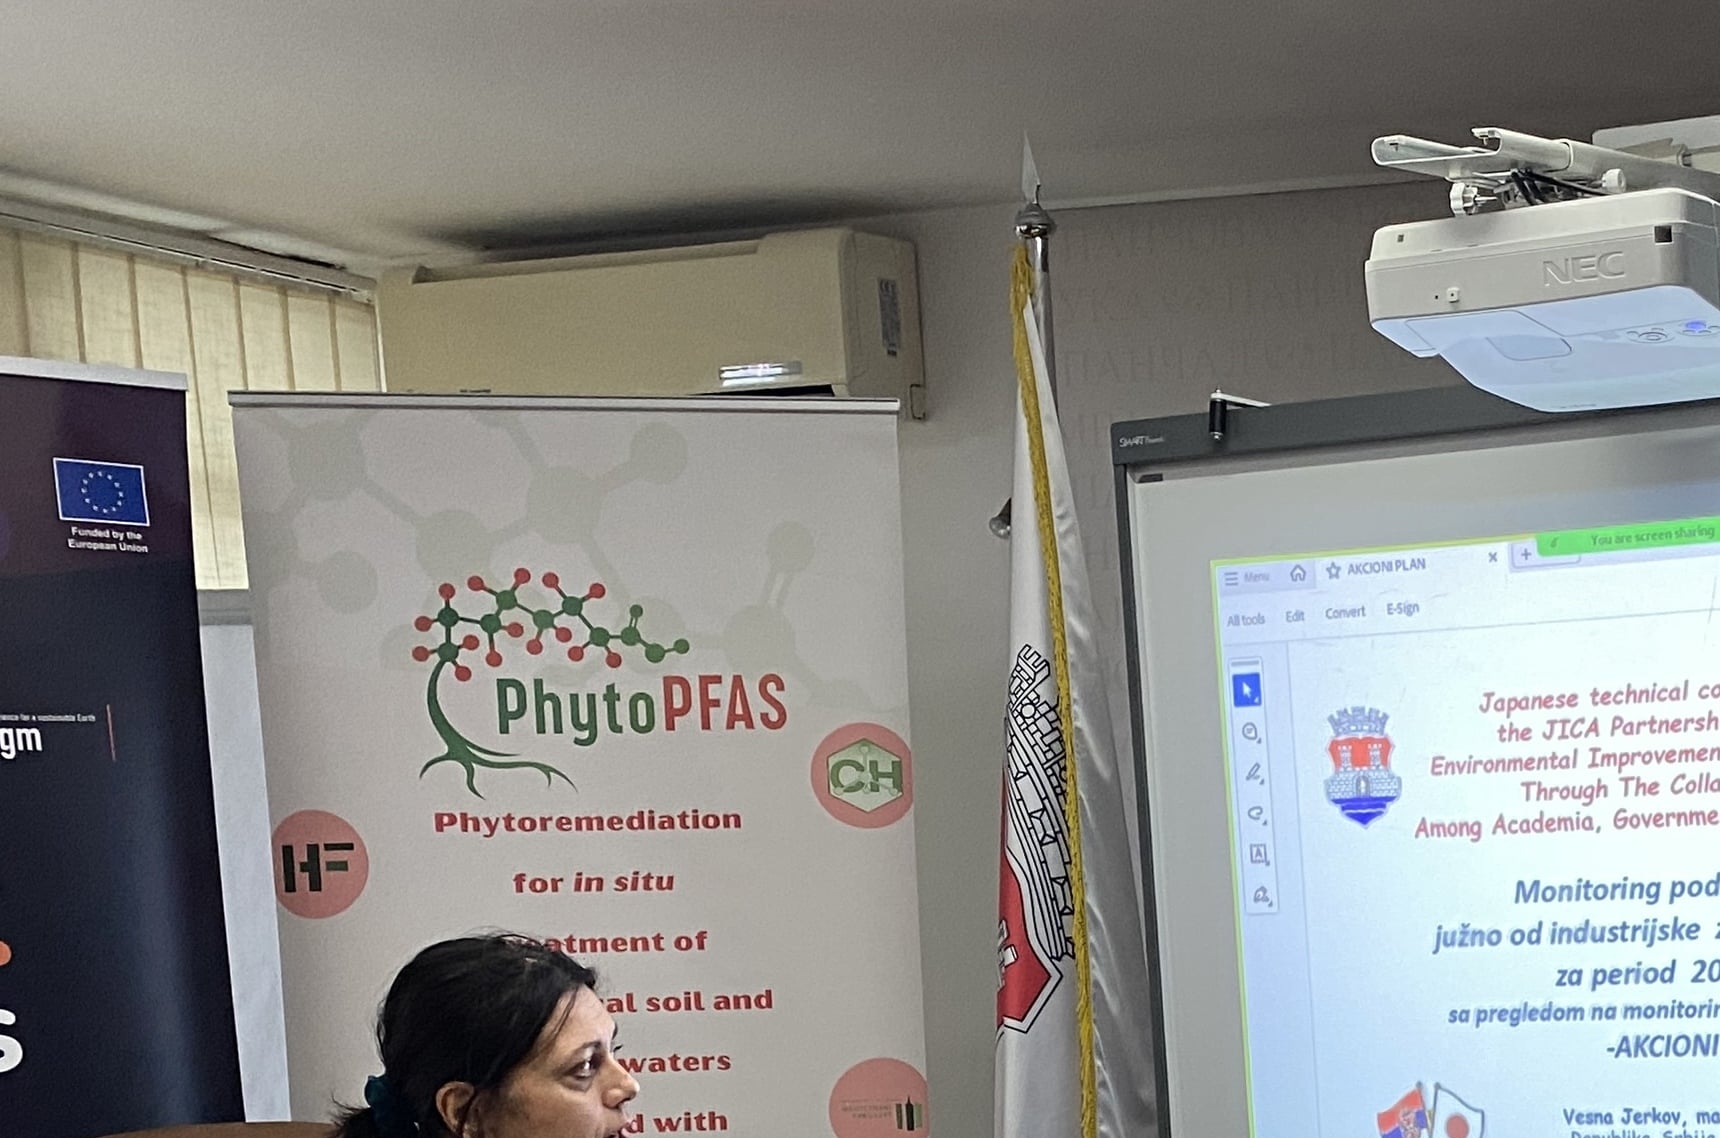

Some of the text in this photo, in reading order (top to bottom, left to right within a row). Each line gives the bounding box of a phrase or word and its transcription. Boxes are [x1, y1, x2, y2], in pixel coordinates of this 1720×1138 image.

[1543, 251, 1627, 287] NEC
[1591, 524, 1715, 547] You are screen sharing
[1244, 571, 1270, 583] Menu
[1347, 558, 1426, 576] AKCIONI PLAN
[1227, 612, 1265, 627] All tools
[1286, 610, 1305, 623] Edit
[1325, 606, 1366, 620] Convert
[1387, 601, 1420, 618] E-Sign
[496, 673, 788, 747] PhytoPFAS
[1479, 691, 1579, 719] Japanese
[1589, 679, 1689, 707] technical
[1497, 722, 1533, 743] the
[1542, 717, 1600, 741] JICA
[1430, 747, 1578, 777] Environmental
[1520, 778, 1609, 807] Through
[1618, 775, 1660, 797] The
[433, 809, 742, 838] Phytoremediation
[1414, 816, 1482, 843] Among
[1491, 810, 1602, 836] Academia,
[512, 870, 675, 895] for in situ
[1514, 876, 1662, 905] Monitoring
[545, 931, 708, 954] atment of
[1432, 922, 1503, 955] južno
[1509, 920, 1544, 946] od
[1549, 916, 1701, 948] industrijske
[1555, 968, 1584, 987] za
[1590, 958, 1677, 992] period
[646, 991, 705, 1013] soil
[713, 989, 774, 1012] and
[1448, 1007, 1470, 1024] sa
[1474, 1001, 1585, 1028] pregledom
[1590, 1005, 1617, 1021] na
[1606, 1033, 1720, 1059] -AKCIONI
[653, 1111, 728, 1133] with
[1563, 1108, 1614, 1126] Vesna
[1620, 1107, 1687, 1128] Jerkov,
